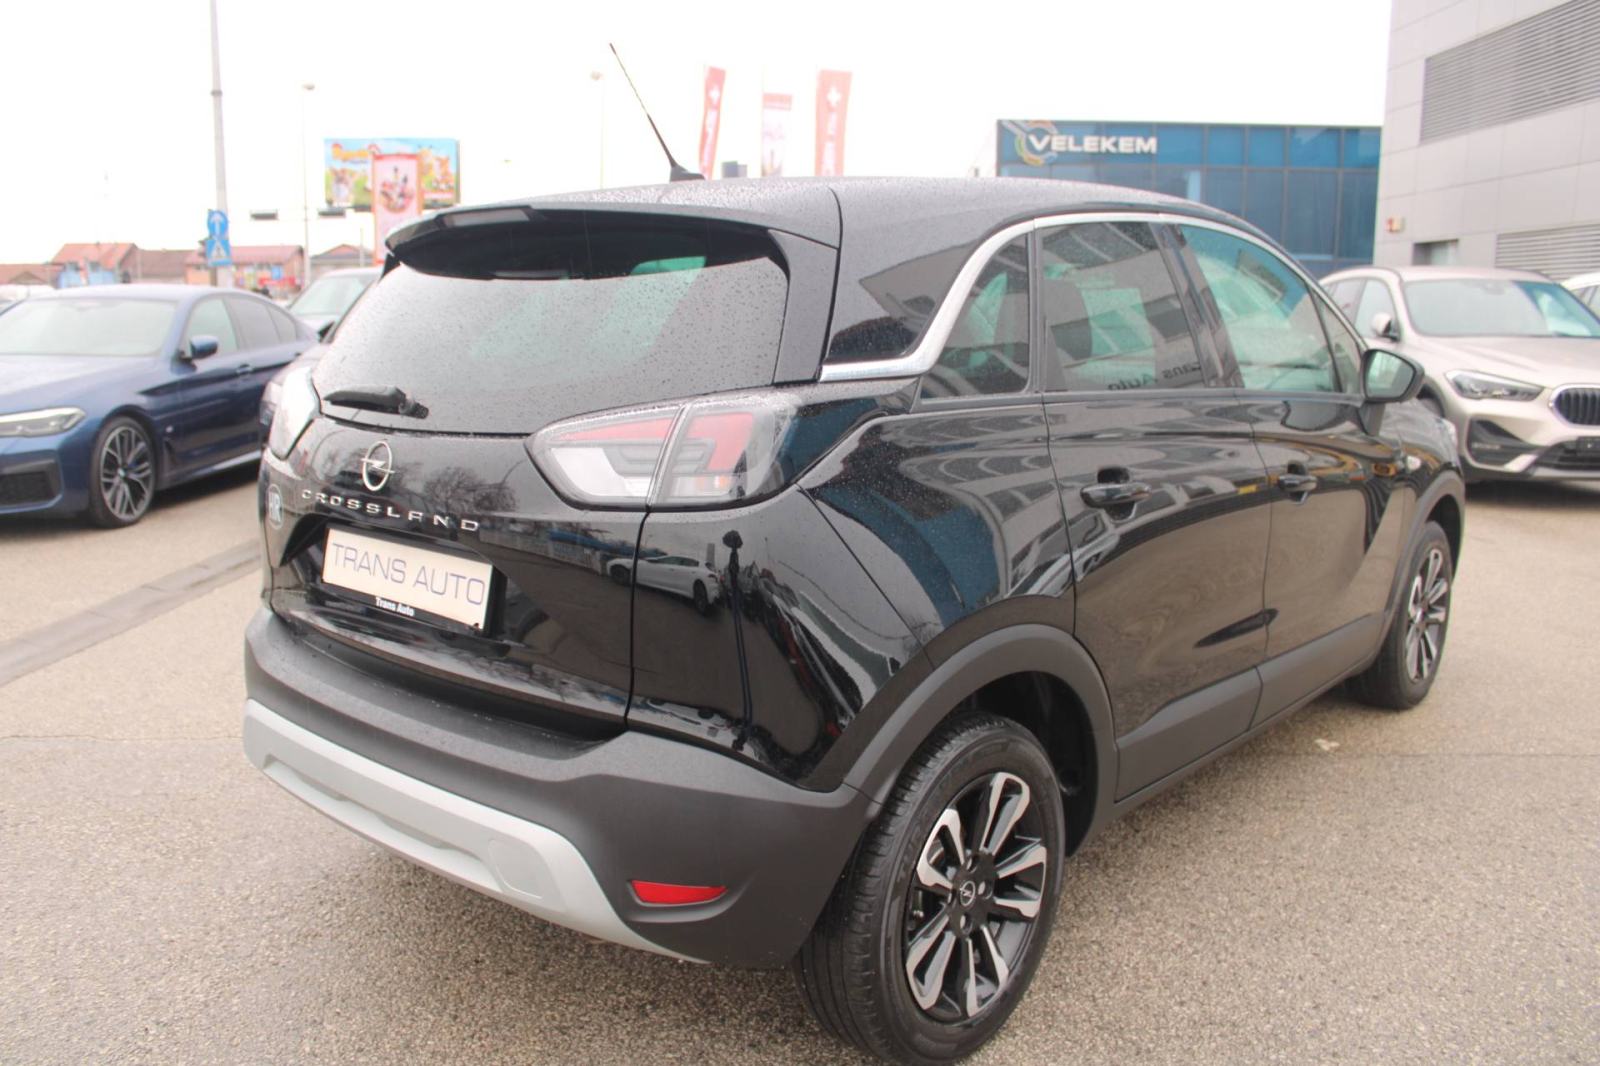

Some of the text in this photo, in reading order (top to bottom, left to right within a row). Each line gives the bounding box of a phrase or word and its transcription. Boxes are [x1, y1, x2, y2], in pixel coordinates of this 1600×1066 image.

[1029, 134, 1157, 154] VELEKEM
[301, 489, 480, 532] CROSSLAND
[332, 543, 486, 605] TRANS AUTO
[375, 596, 415, 617] Trans Auto
